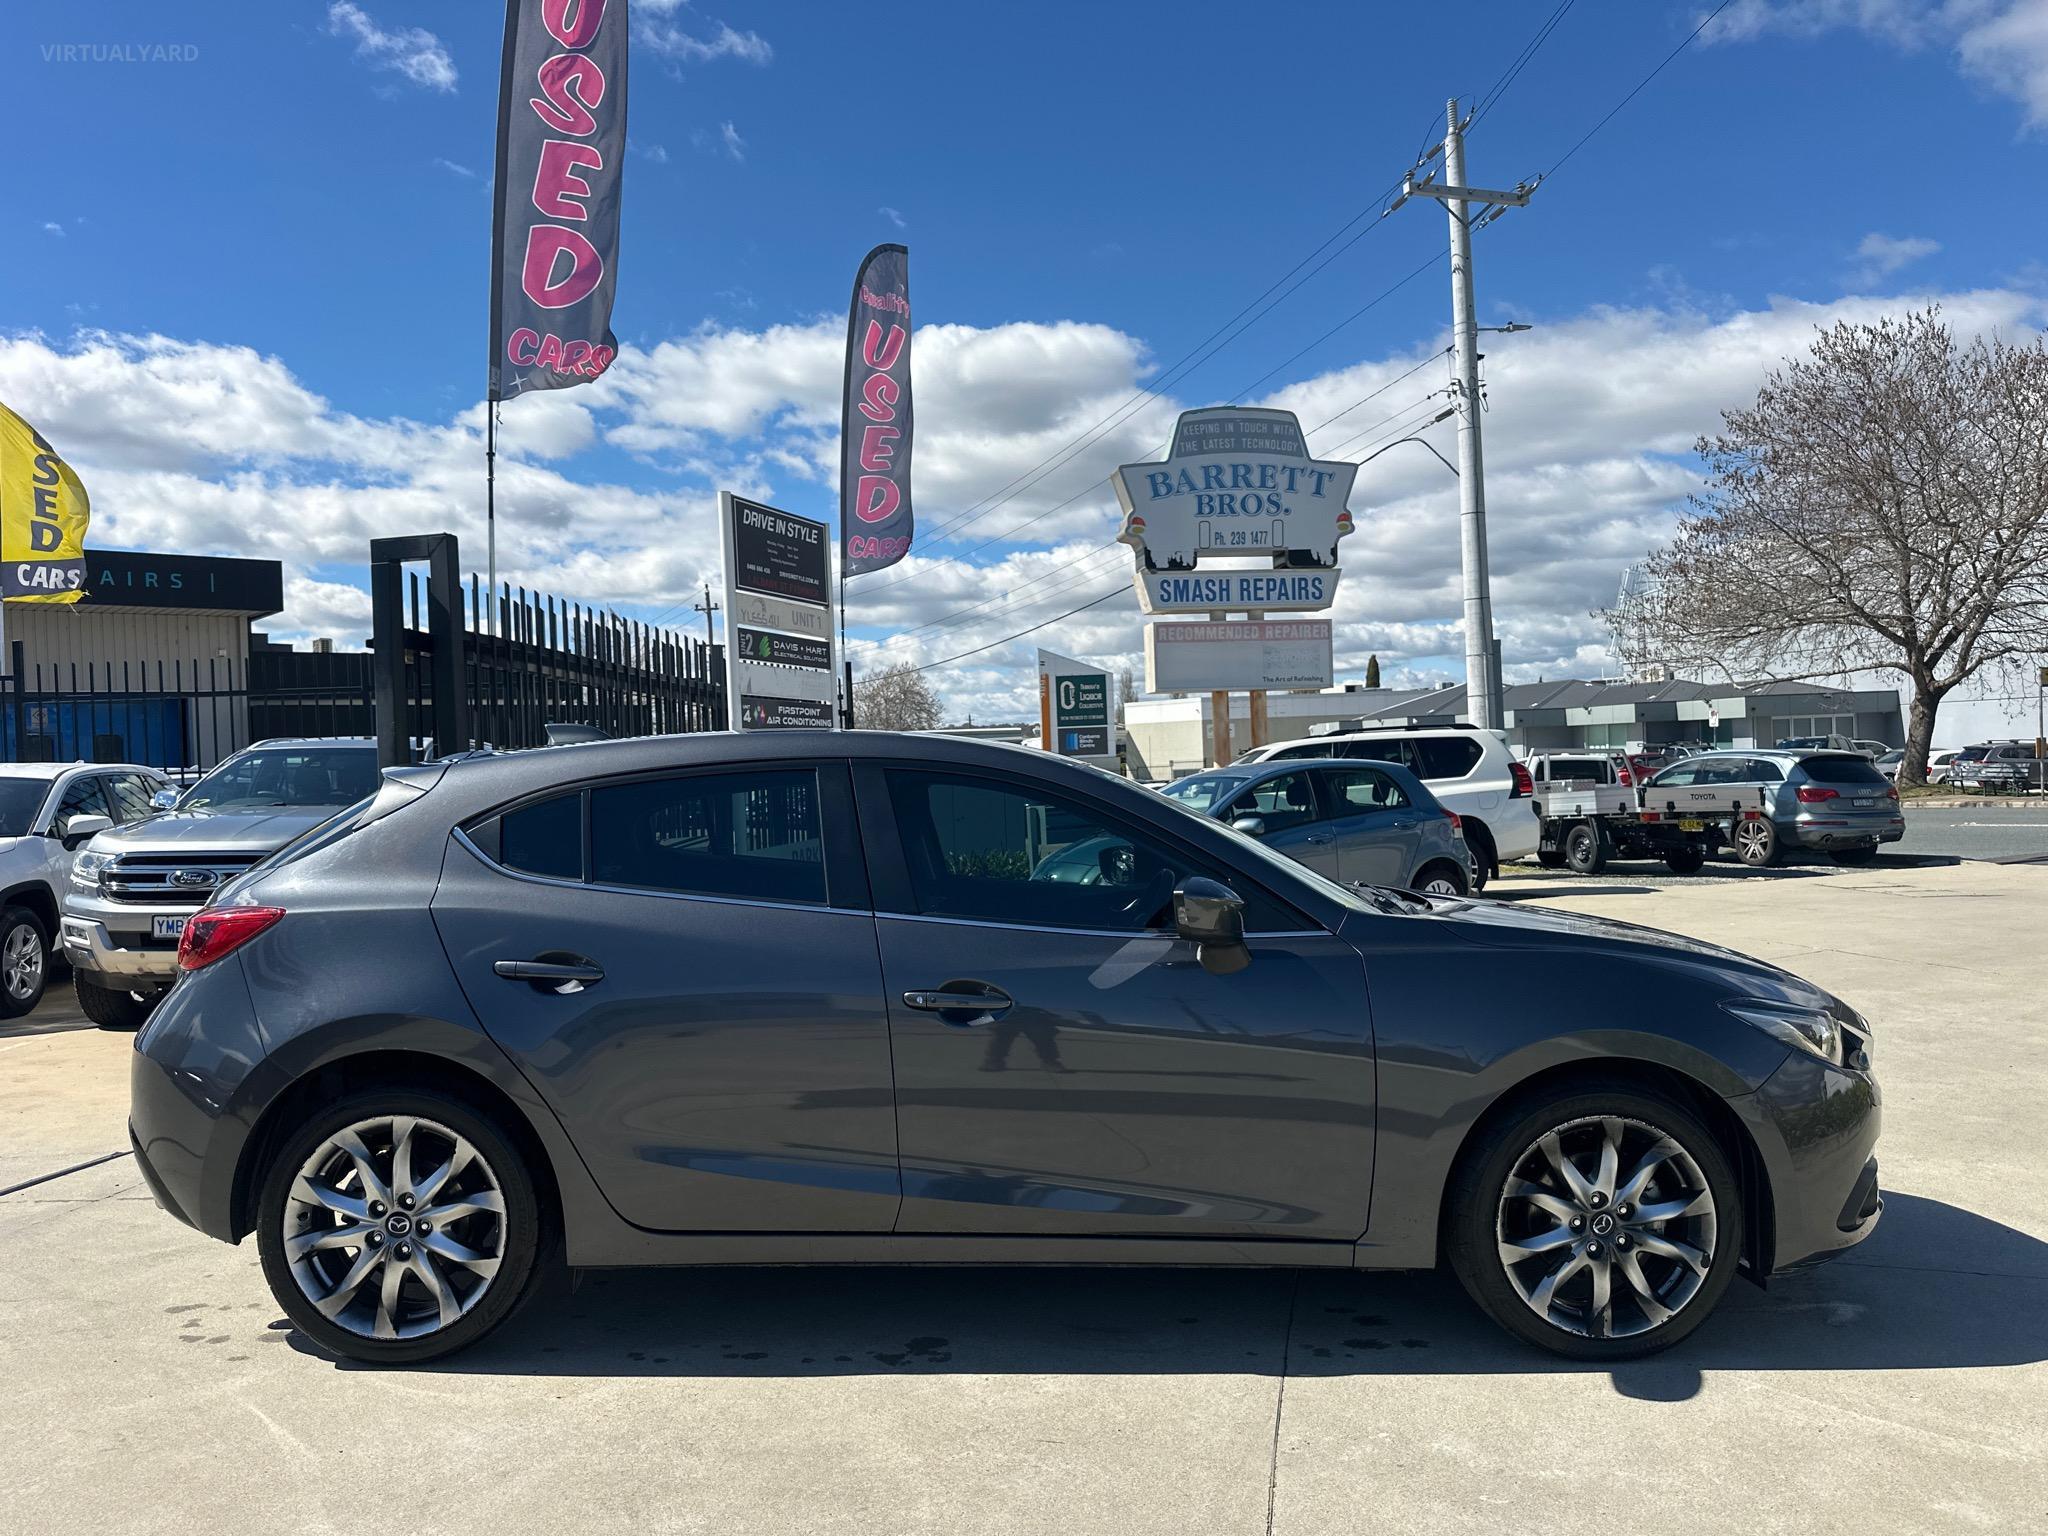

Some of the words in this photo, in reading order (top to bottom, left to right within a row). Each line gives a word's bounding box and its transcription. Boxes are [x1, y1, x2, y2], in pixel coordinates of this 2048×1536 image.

[507, 327, 614, 379] CARS
[855, 319, 906, 524] USED
[1182, 422, 1220, 436] KEEPING
[1224, 422, 1235, 433] IN
[1239, 422, 1268, 433] TOUCH
[1272, 423, 1295, 436] WITH
[1180, 440, 1198, 451] THE
[1202, 438, 1235, 450] LATEST
[1241, 438, 1299, 452] TECHNOLOGY
[1147, 463, 1336, 500] BARRETT
[1194, 492, 1293, 518] BROS.
[743, 508, 775, 532] DRIVE
[775, 519, 787, 536] IN
[787, 522, 819, 545] STYLE
[1215, 531, 1226, 545] Ph.
[1230, 531, 1246, 546] 239
[1250, 531, 1268, 546] 1477
[17, 563, 81, 590] CARS
[1159, 578, 1231, 603] SMASH
[1239, 576, 1324, 602] REPAIRS
[791, 610, 815, 629] UNIT
[1158, 626, 1260, 641] RECOMMENDED
[1265, 623, 1329, 640] REPAIRER
[746, 633, 754, 656] 2
[773, 640, 799, 652] DAVIS
[805, 646, 827, 656] HART
[743, 709, 752, 723] 4
[778, 705, 821, 717] FIRSTPOINT
[766, 715, 781, 725] AIR
[782, 715, 832, 728] CONDITIONING
